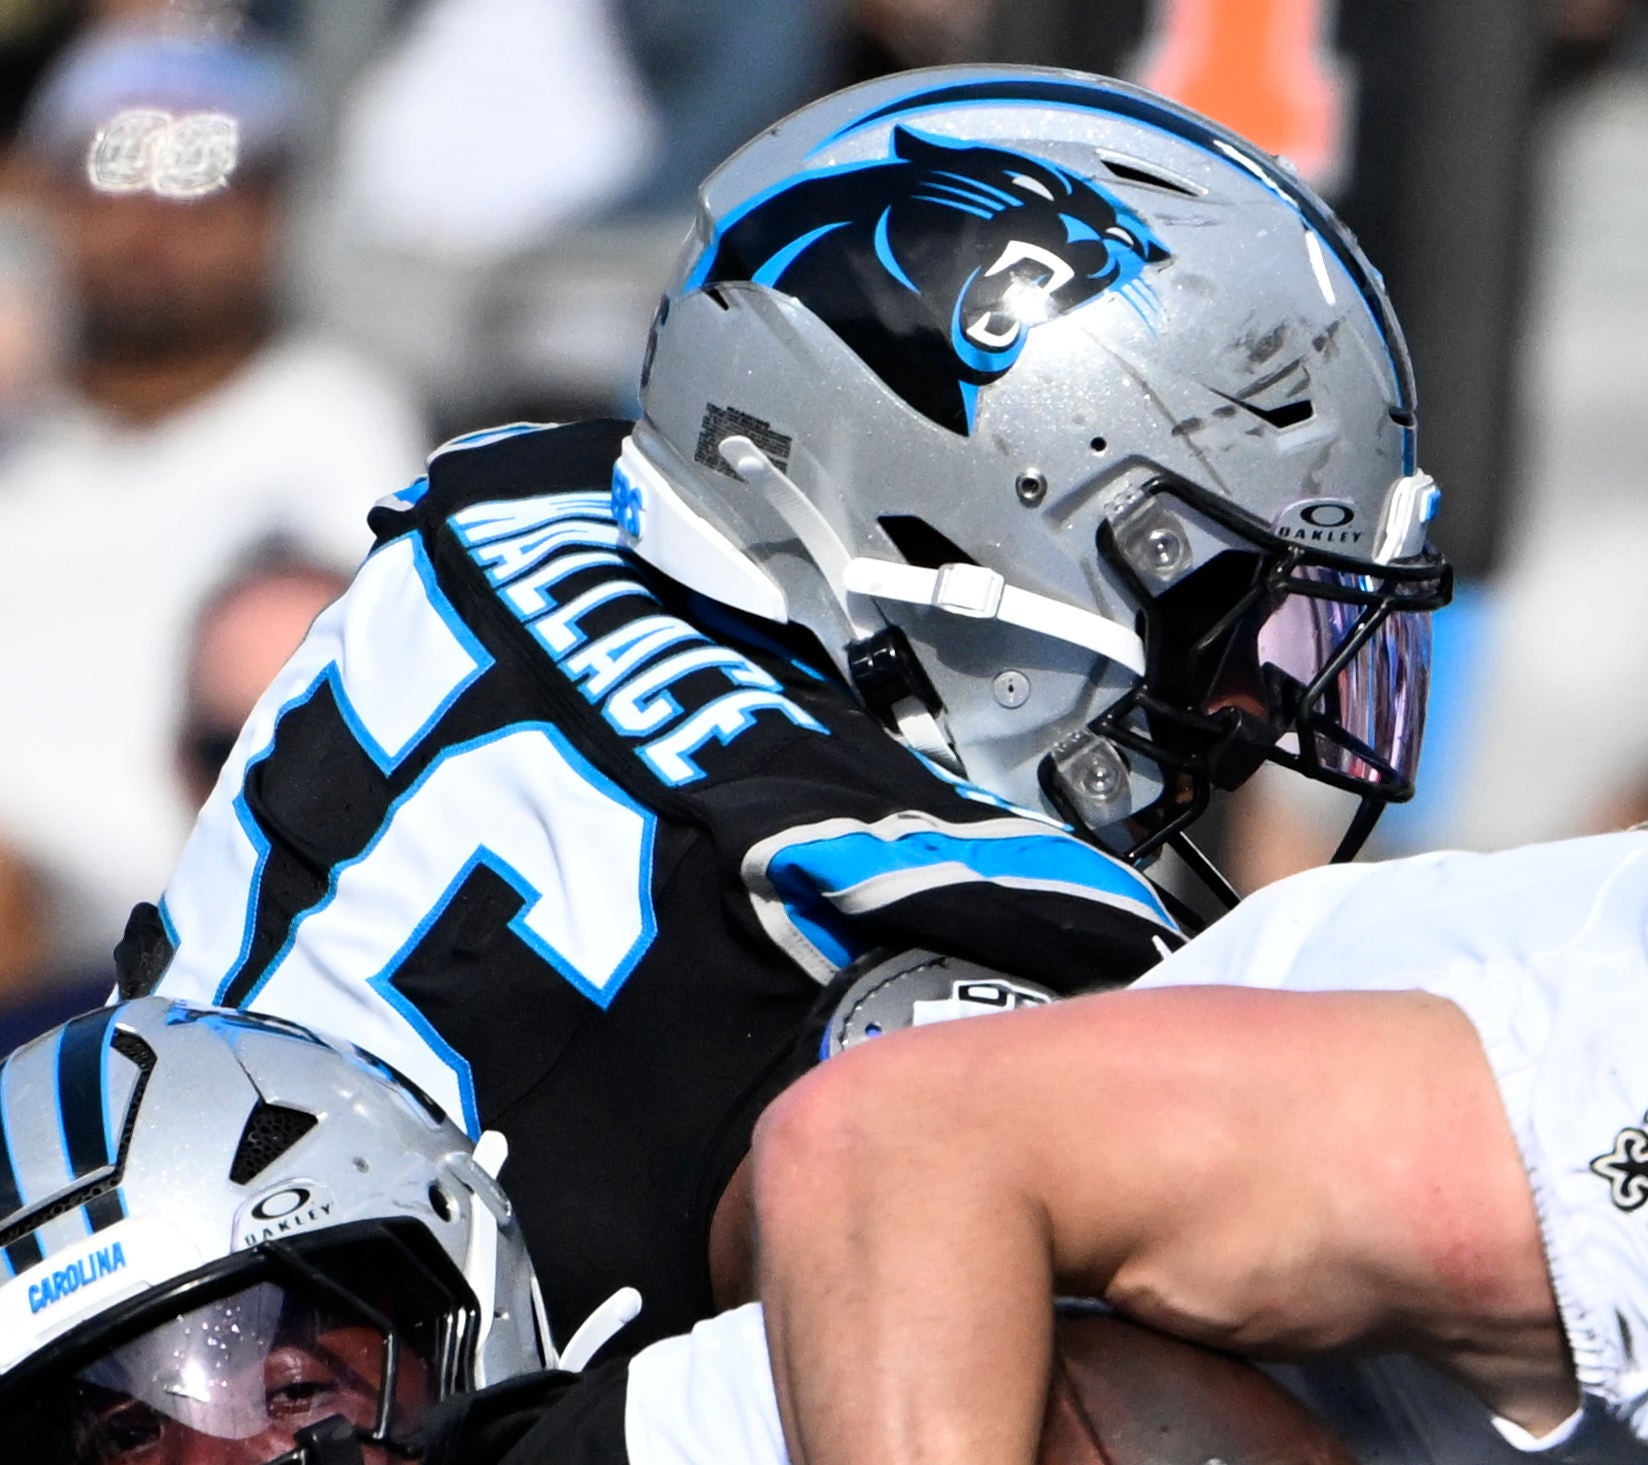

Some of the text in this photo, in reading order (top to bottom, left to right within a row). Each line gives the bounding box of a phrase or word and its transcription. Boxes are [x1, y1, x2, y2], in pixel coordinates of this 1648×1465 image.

[1278, 525, 1362, 543] OAKLEY
[446, 490, 832, 787] WALLACE
[244, 1202, 330, 1247] OAKLEY
[27, 1240, 127, 1314] CAROLINA
